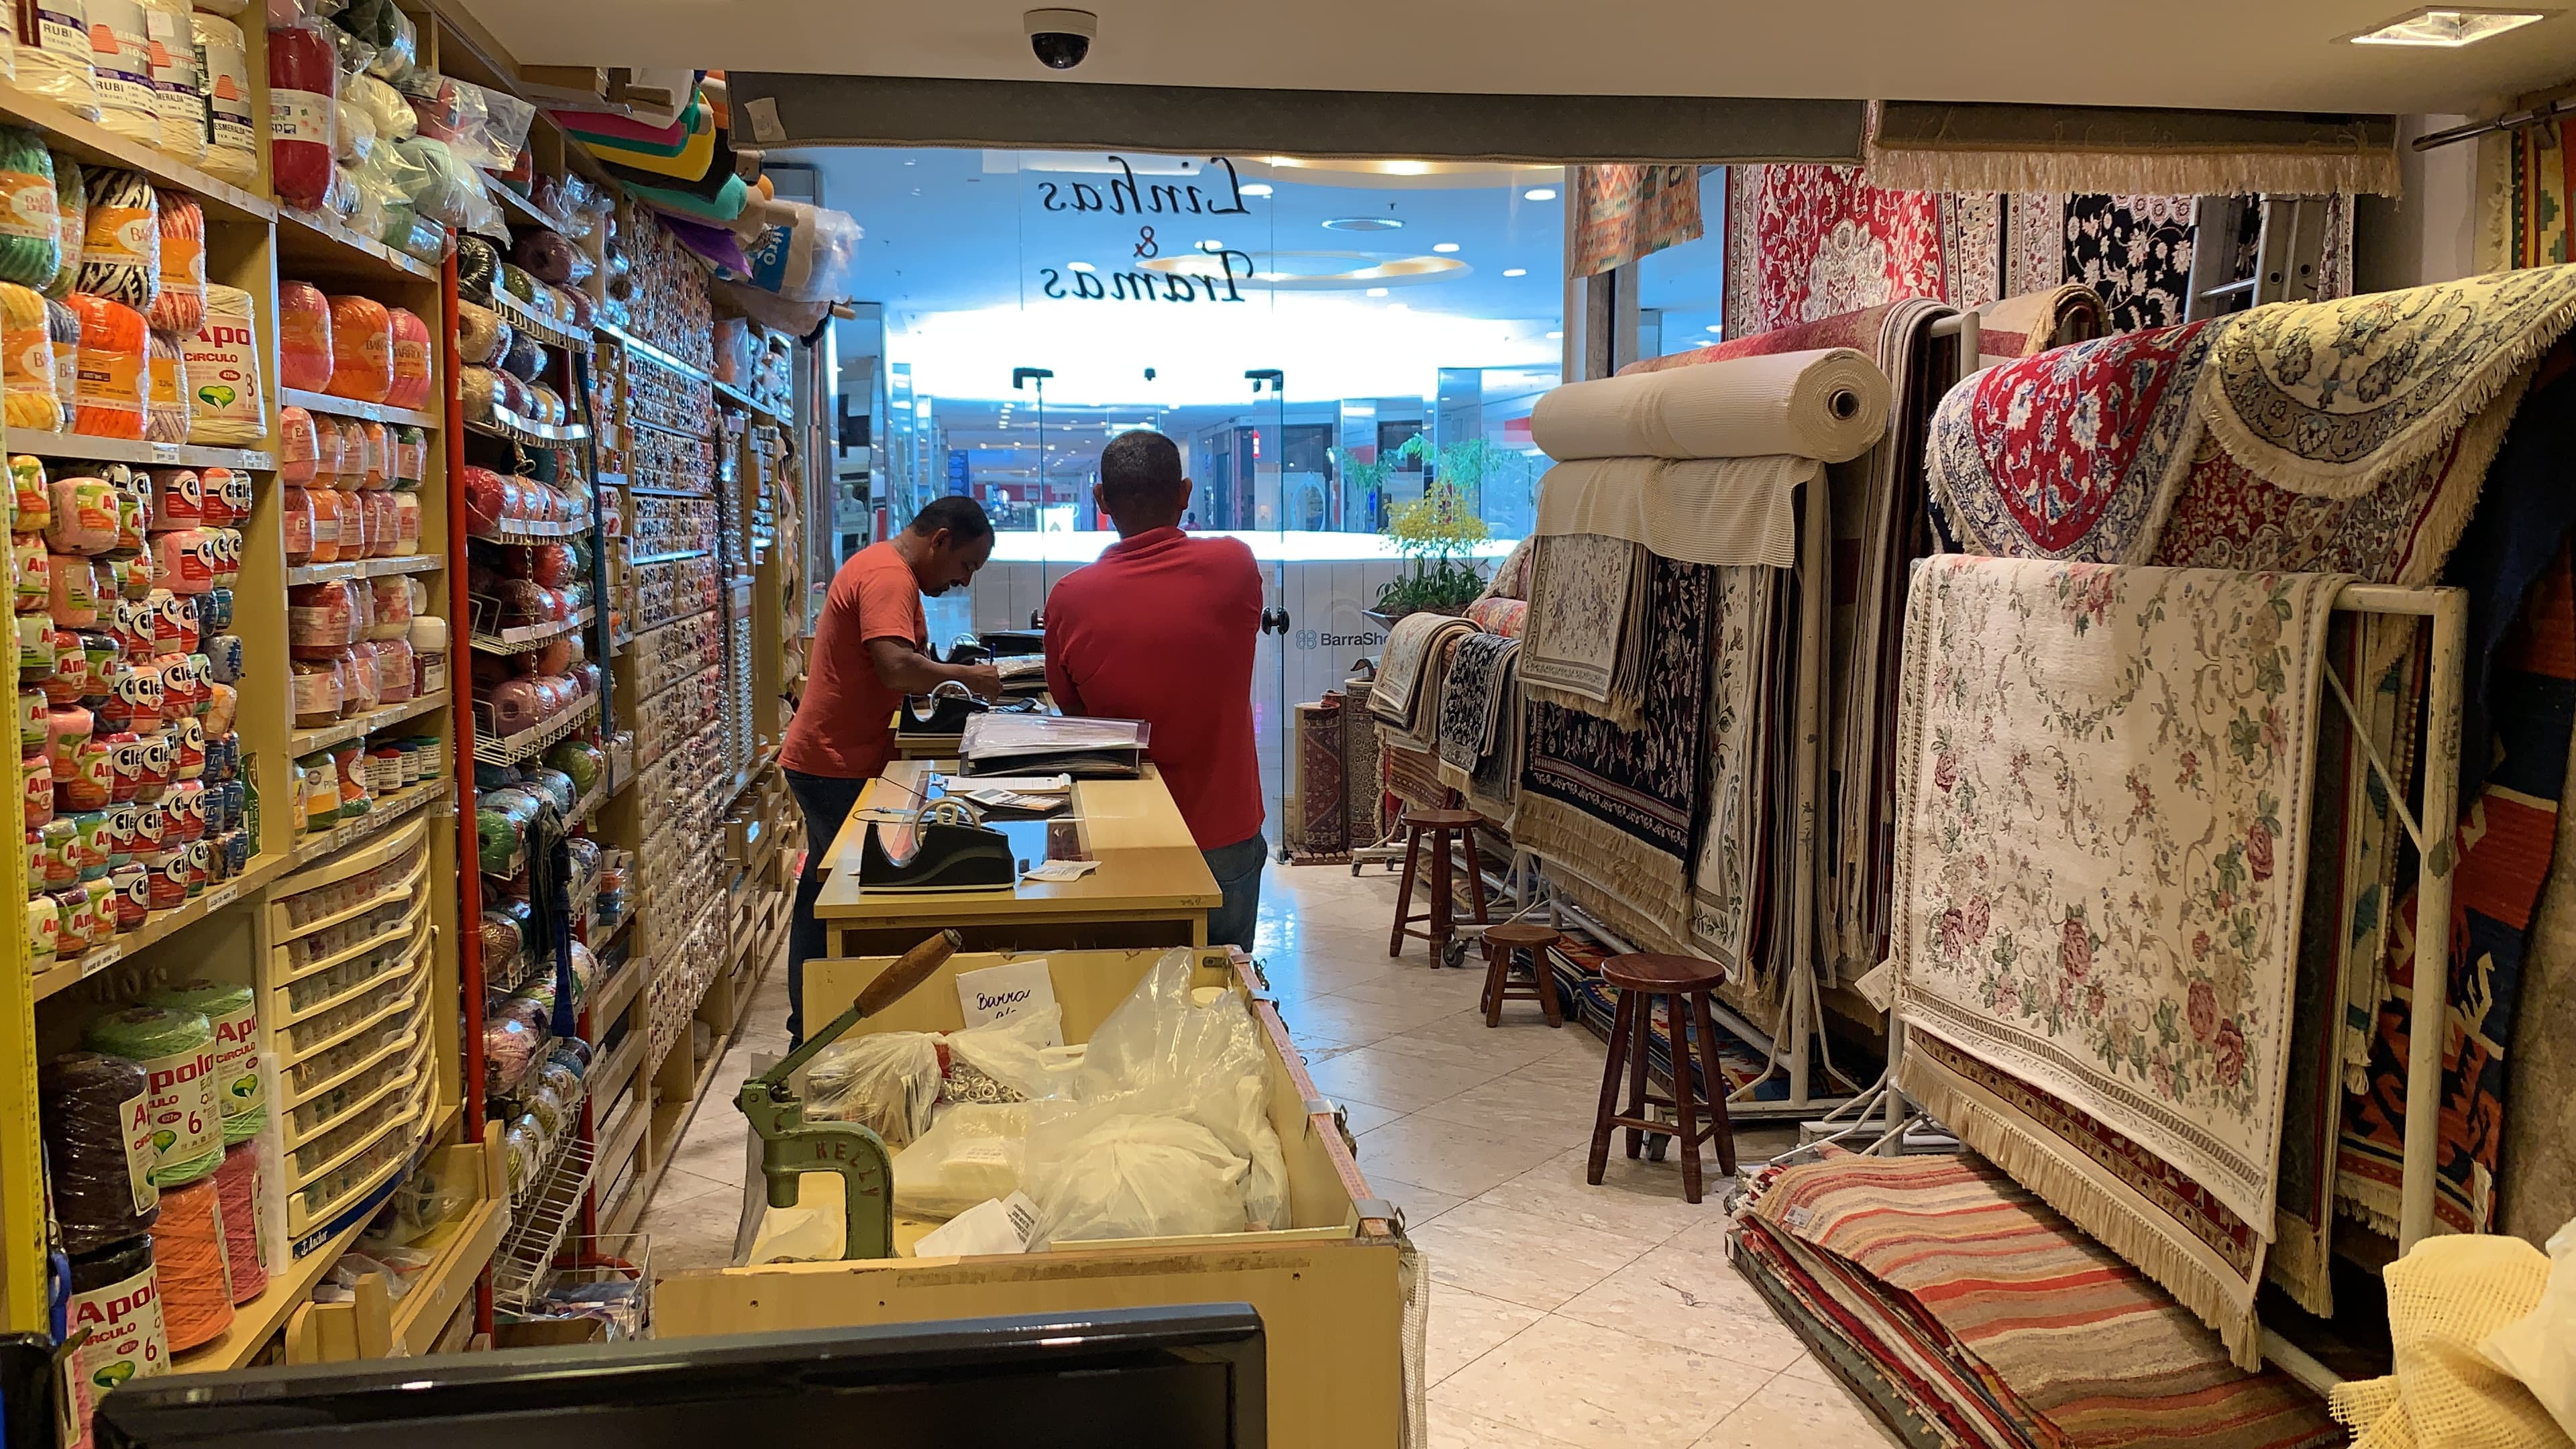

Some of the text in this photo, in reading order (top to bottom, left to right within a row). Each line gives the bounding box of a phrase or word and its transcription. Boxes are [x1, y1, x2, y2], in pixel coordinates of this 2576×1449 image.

[43, 23, 72, 38] RUBI
[97, 80, 124, 93] RUBI
[156, 92, 183, 103] MERALDA
[215, 123, 245, 135] ESMERALDA
[246, 373, 254, 397] 8
[977, 989, 1031, 1010] Barra
[149, 1054, 214, 1095] polo
[189, 1110, 202, 1134] 6
[816, 1140, 880, 1197] KELLY
[309, 1230, 328, 1250] Anchor
[145, 1336, 157, 1362] 6
